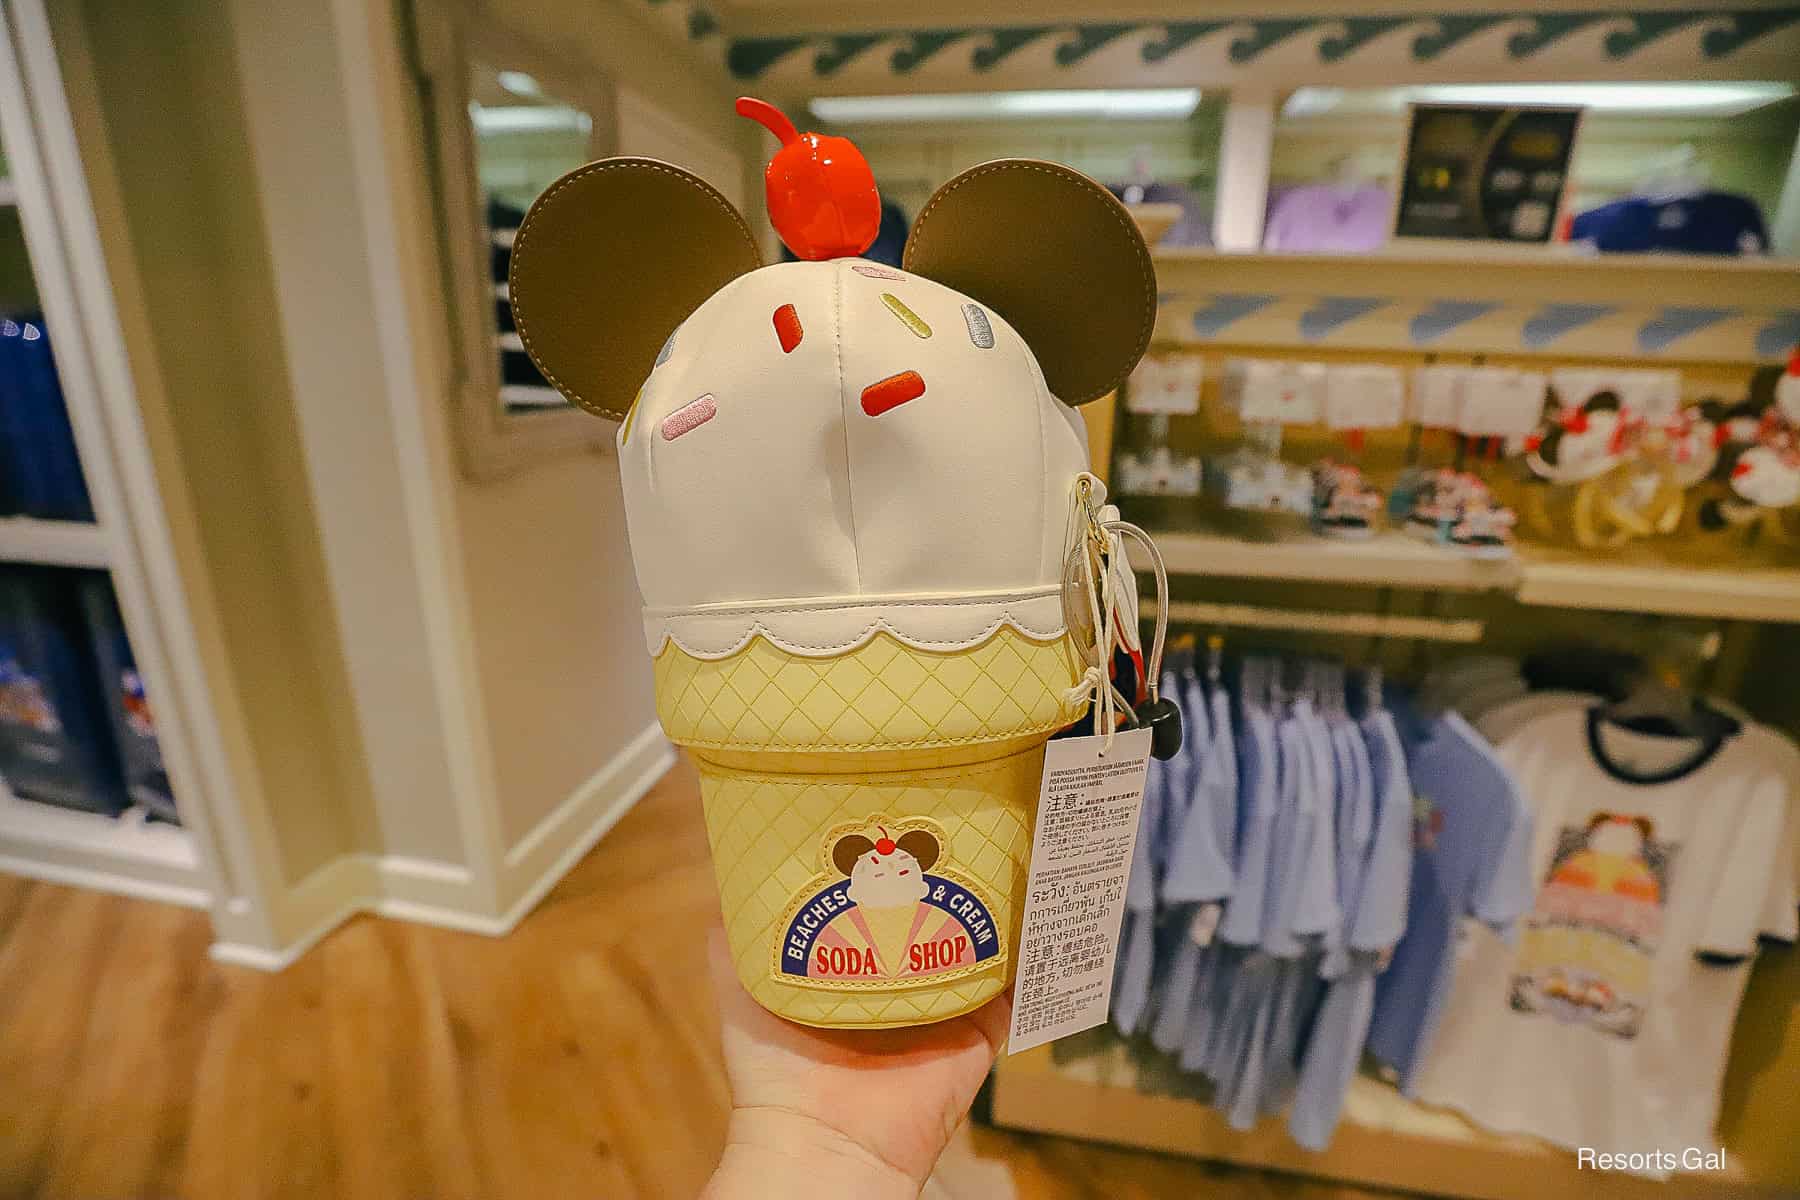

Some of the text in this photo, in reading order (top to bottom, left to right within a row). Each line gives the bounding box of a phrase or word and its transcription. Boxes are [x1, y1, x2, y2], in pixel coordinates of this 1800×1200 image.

[787, 884, 993, 960] BEACHES & CREAM
[816, 935, 967, 976] SODA SHOP
